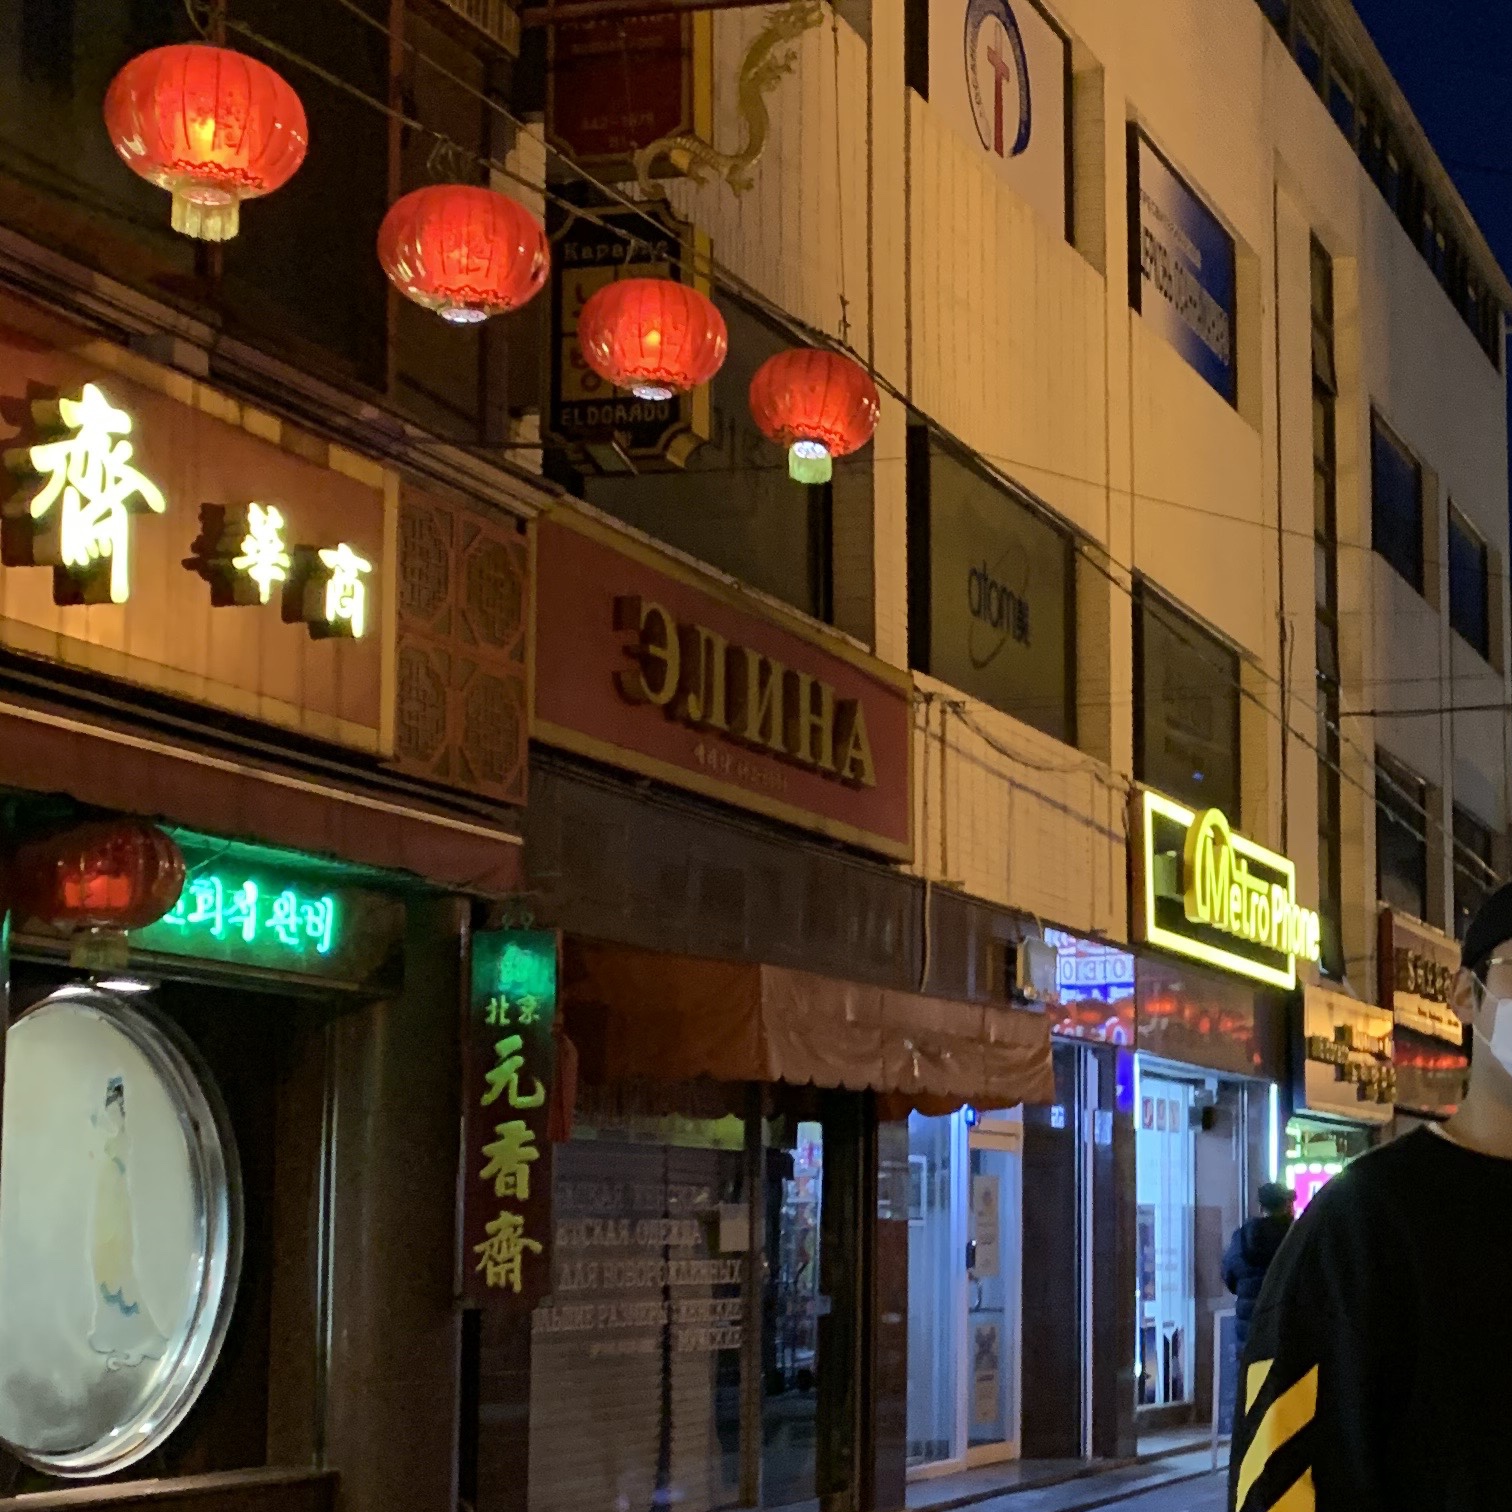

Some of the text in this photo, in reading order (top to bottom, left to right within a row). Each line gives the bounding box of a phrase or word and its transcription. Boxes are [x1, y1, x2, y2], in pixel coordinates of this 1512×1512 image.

[561, 403, 671, 427] ELDORADO
[639, 601, 877, 788] ЭЛИНА
[265, 890, 334, 954] 완비
[484, 993, 542, 1027] 北京
